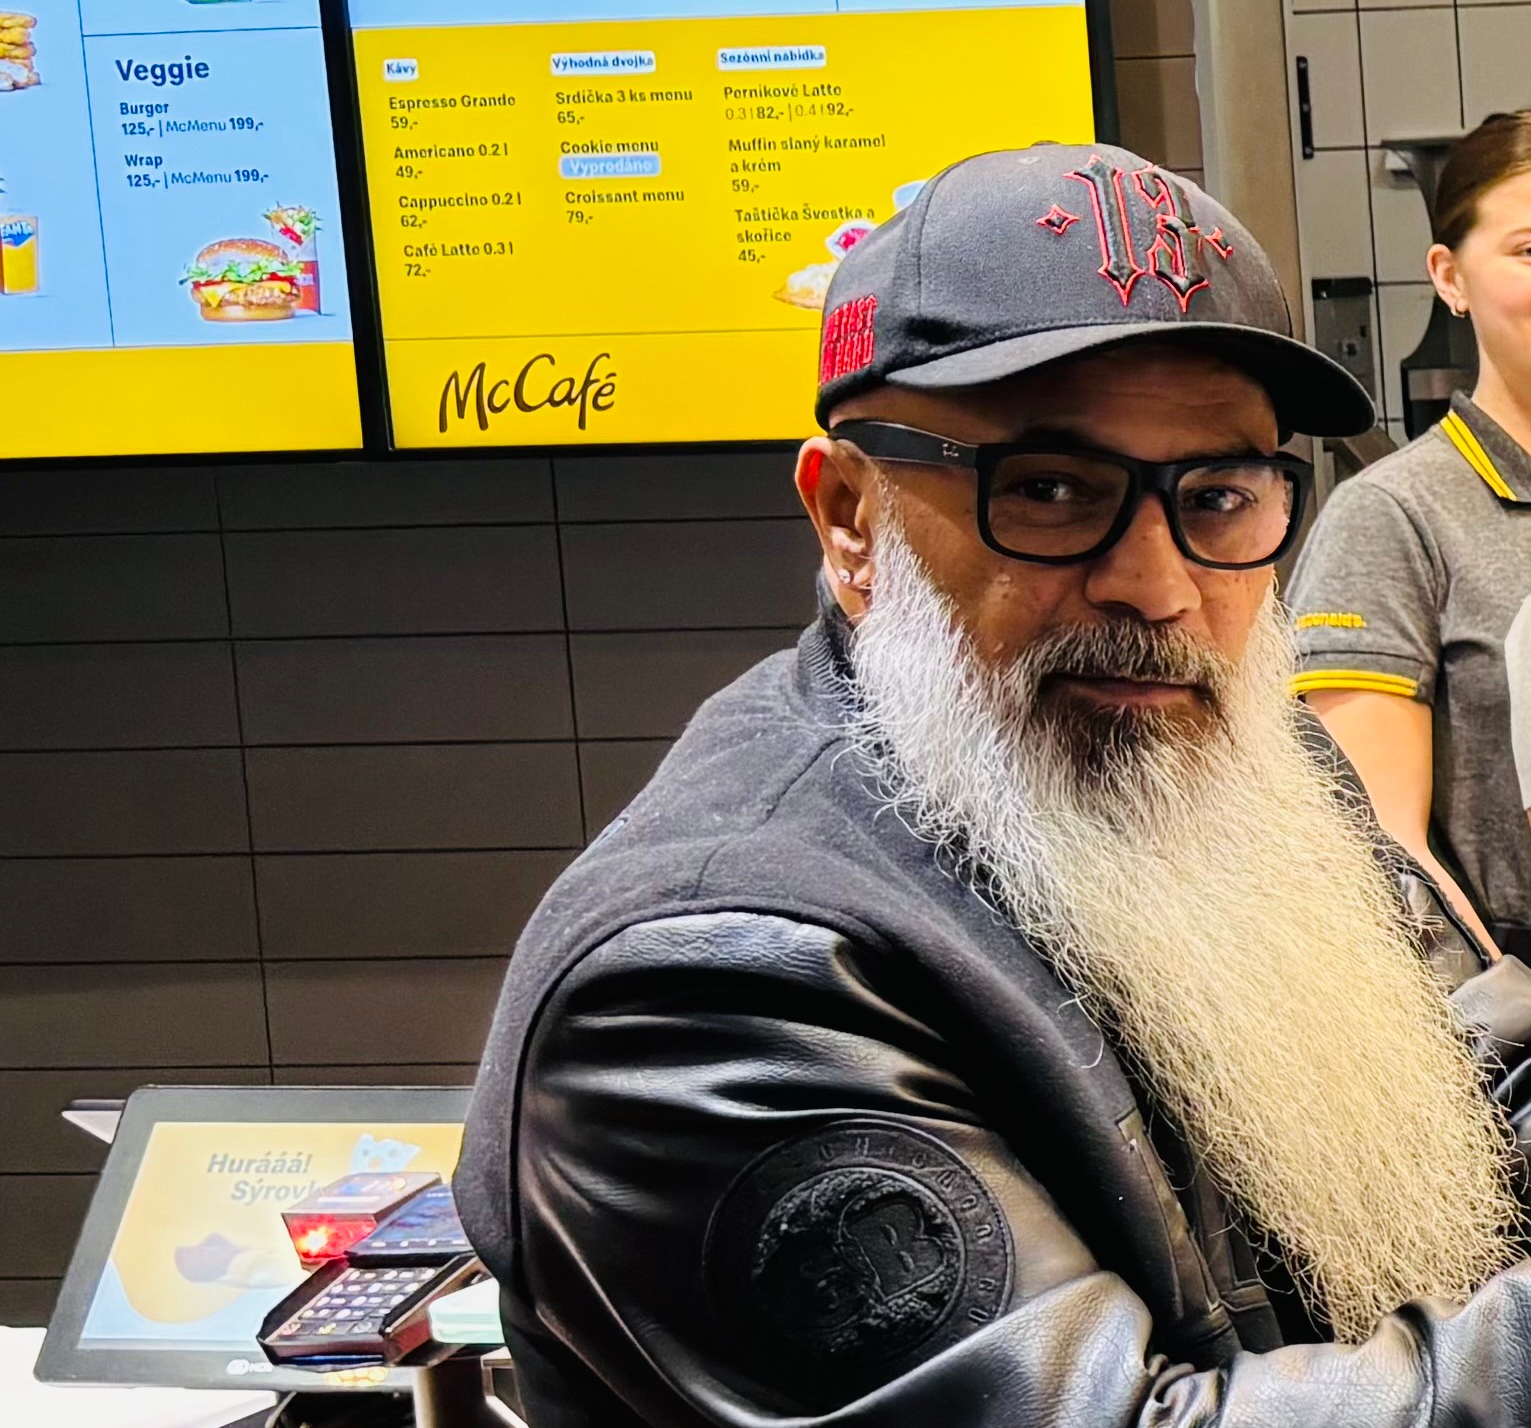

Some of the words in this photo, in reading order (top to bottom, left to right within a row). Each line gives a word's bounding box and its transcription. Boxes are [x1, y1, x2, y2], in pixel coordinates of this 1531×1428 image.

[116, 55, 210, 86] Veggie
[120, 102, 169, 117] Burger
[390, 96, 457, 112] Espresso
[461, 94, 516, 109] Grande
[391, 116, 418, 131] 59,-
[558, 111, 585, 126] 65,-
[122, 123, 154, 136] 125,-
[166, 120, 226, 132] McMenu
[229, 118, 264, 132] 199,-
[560, 140, 613, 155] Cookie
[616, 140, 659, 153] menu
[125, 154, 163, 169] Wrap
[127, 175, 160, 188] 125,-
[171, 171, 231, 185] McMenu
[234, 169, 269, 183] 199,-
[565, 189, 639, 205] Croissant
[400, 215, 427, 229] 62,-
[566, 211, 593, 225] 79,-
[738, 249, 766, 264] 45,-
[405, 264, 431, 278] 72,-
[437, 353, 618, 432] McCafé
[207, 1151, 313, 1174] Hurááá!
